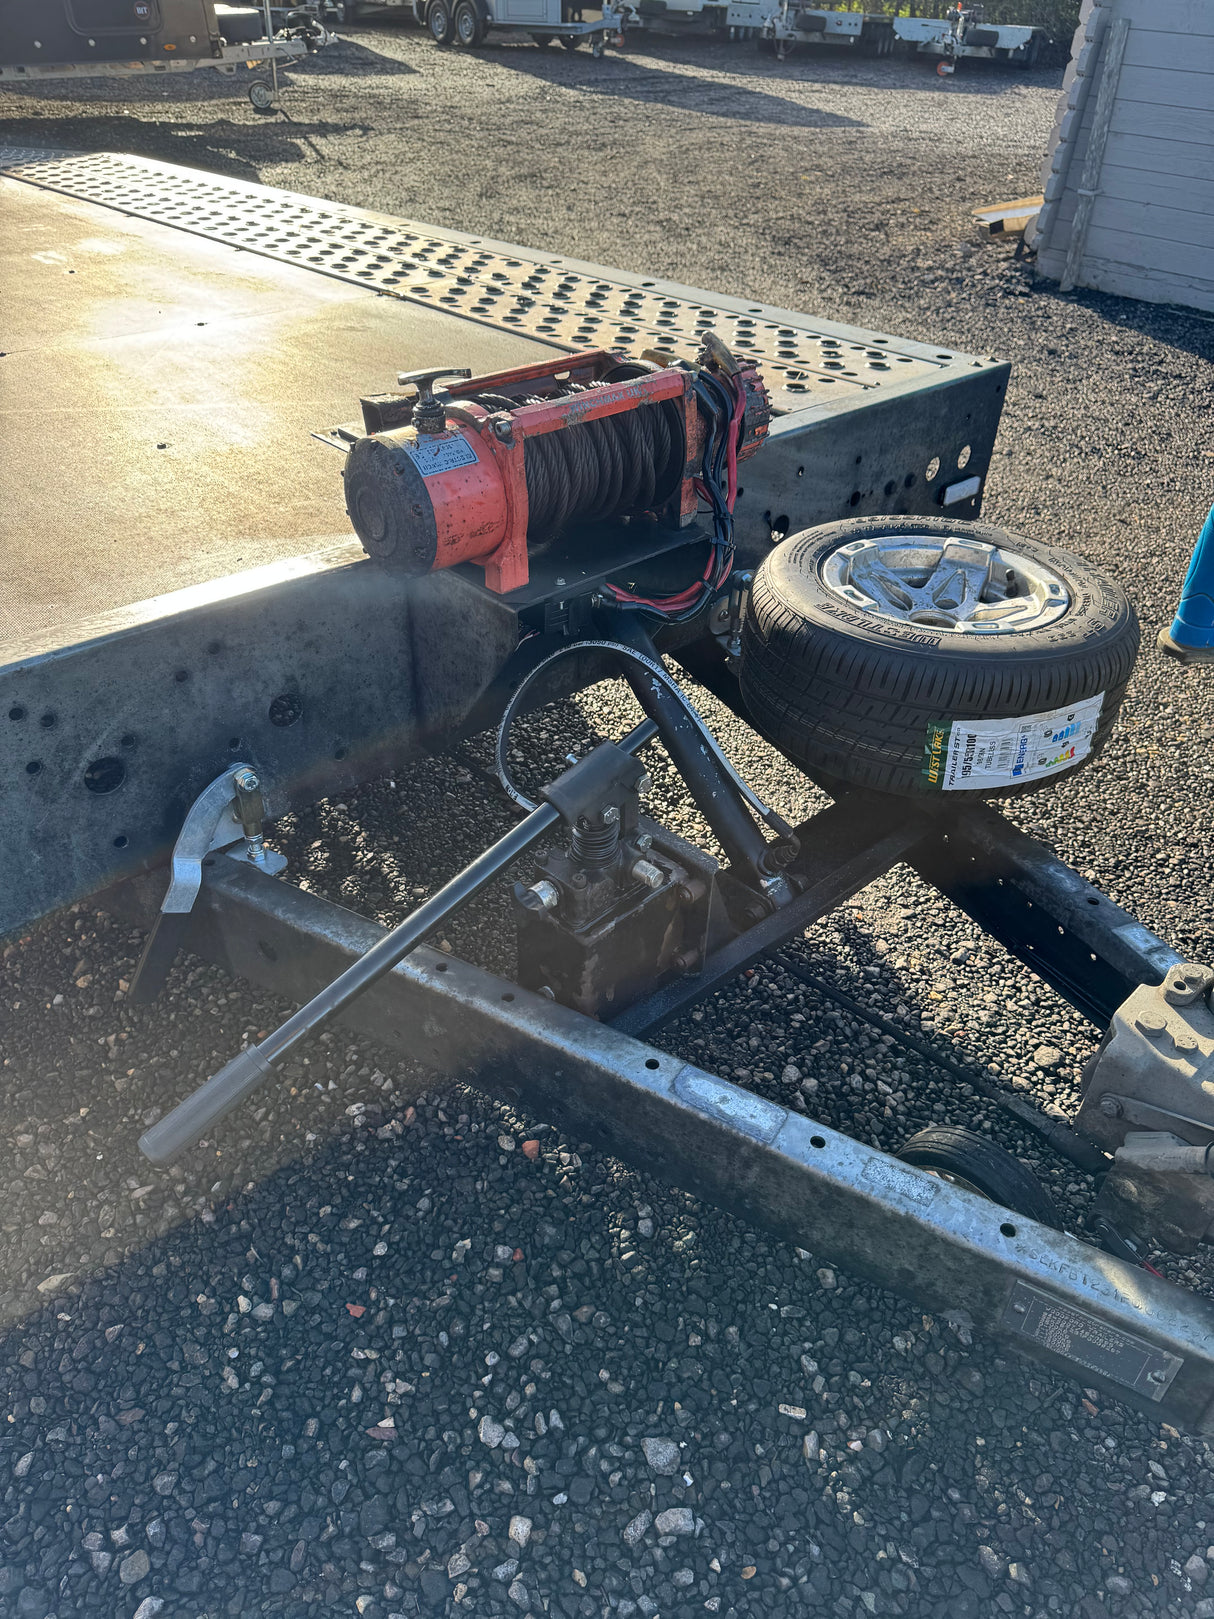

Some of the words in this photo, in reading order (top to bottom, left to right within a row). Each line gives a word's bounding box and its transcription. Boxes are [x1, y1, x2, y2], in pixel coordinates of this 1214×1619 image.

[953, 736, 961, 750] ST
[948, 749, 960, 786] TRAILER
[1044, 1305, 1083, 1328] WOODFORD
[1087, 1326, 1124, 1348] TRAILERS
